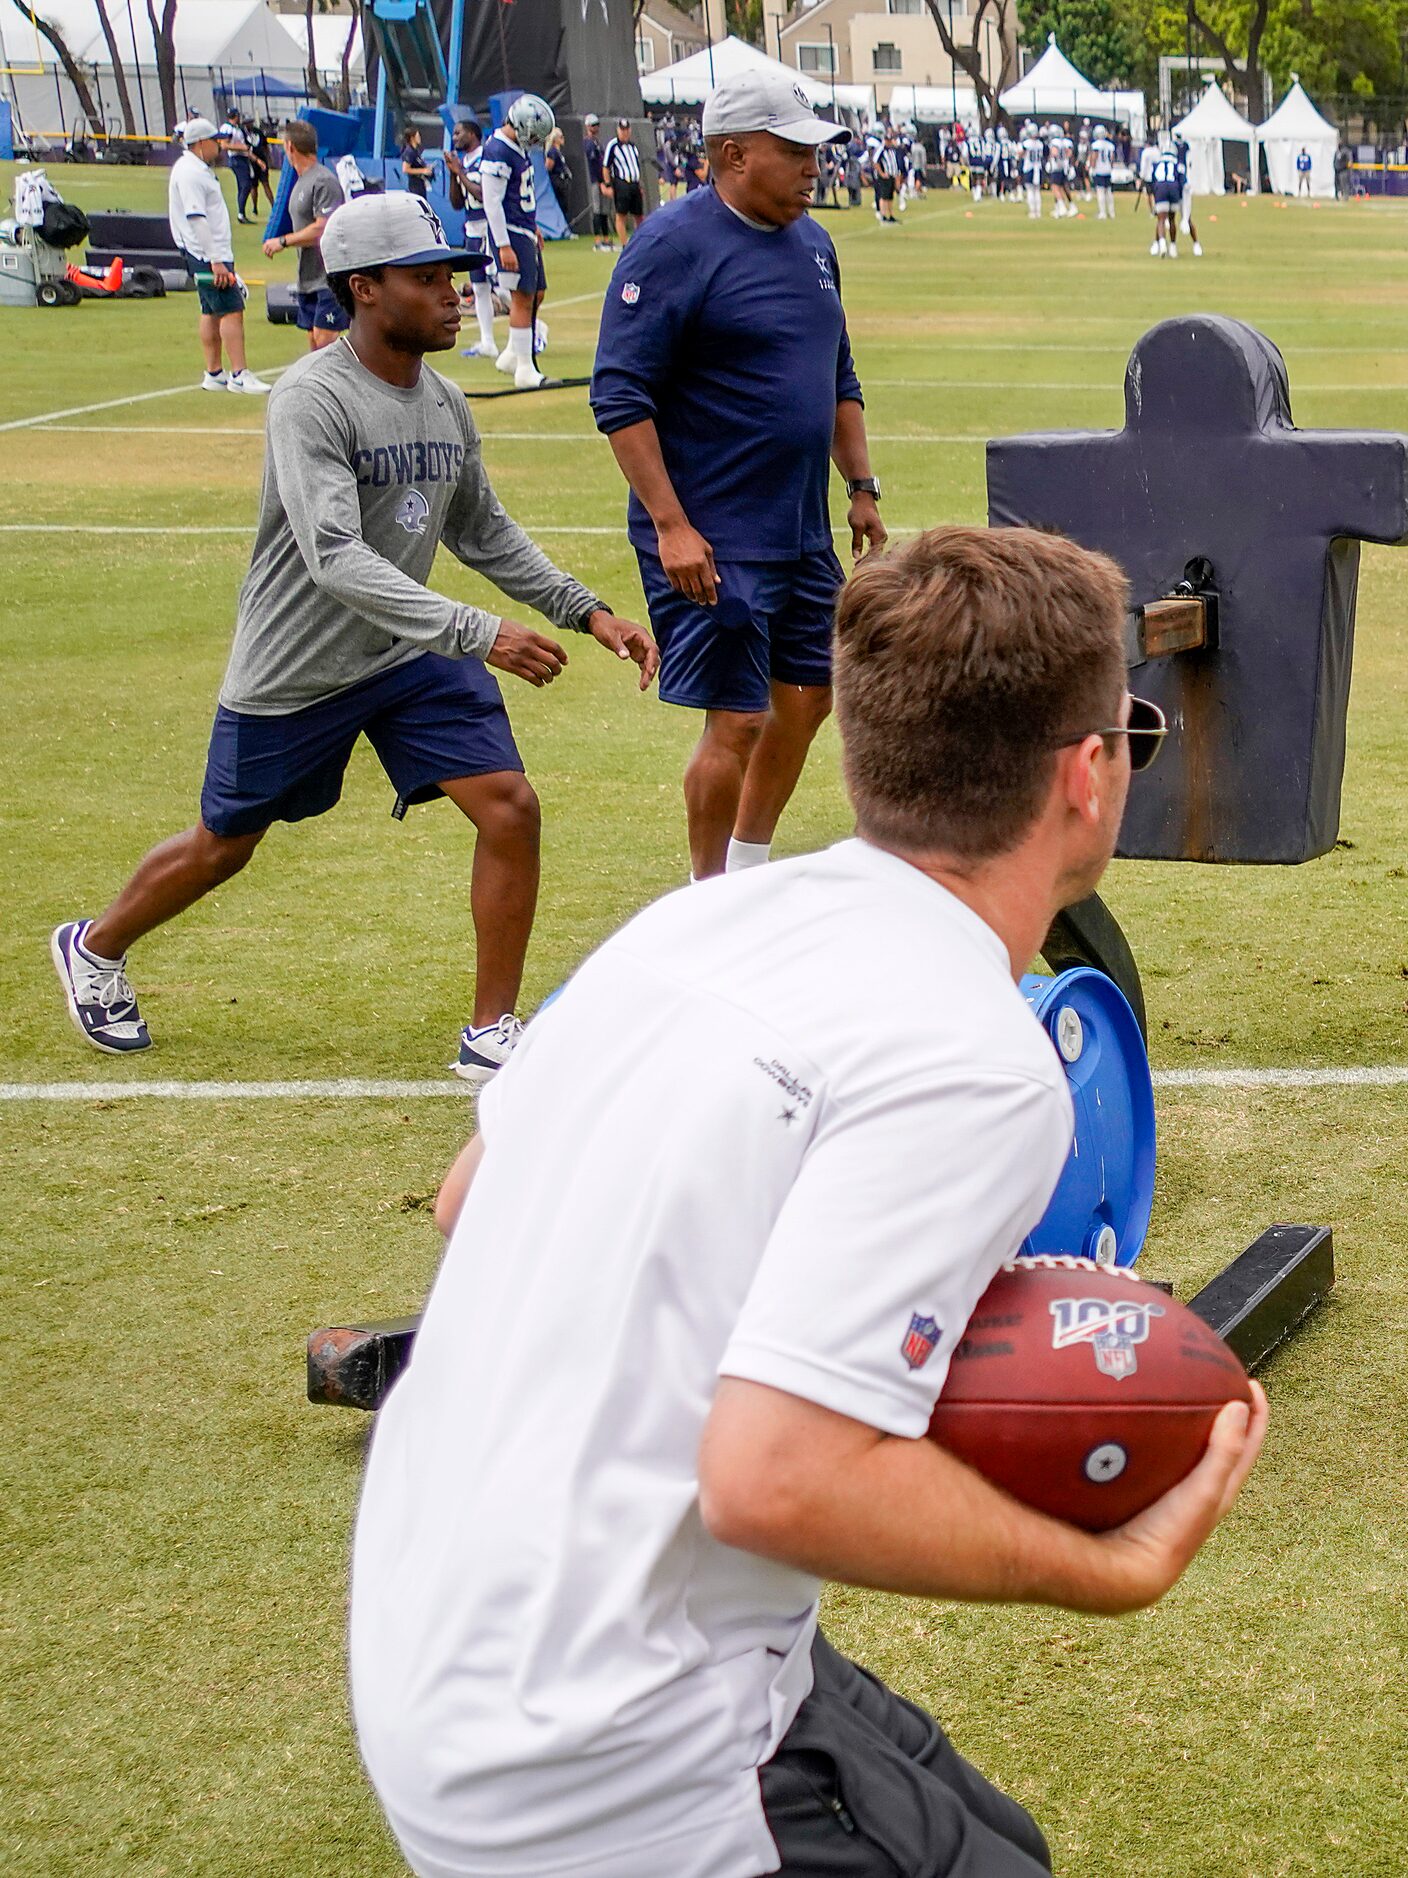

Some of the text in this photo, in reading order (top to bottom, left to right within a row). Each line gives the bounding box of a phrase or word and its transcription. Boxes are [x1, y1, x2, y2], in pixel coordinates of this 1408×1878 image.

[1154, 162, 1175, 182] 41
[353, 441, 463, 488] COWBOYS
[753, 1056, 809, 1108] COWBOYS
[1051, 1299, 1147, 1345] 100
[1102, 1350, 1132, 1370] NFL
